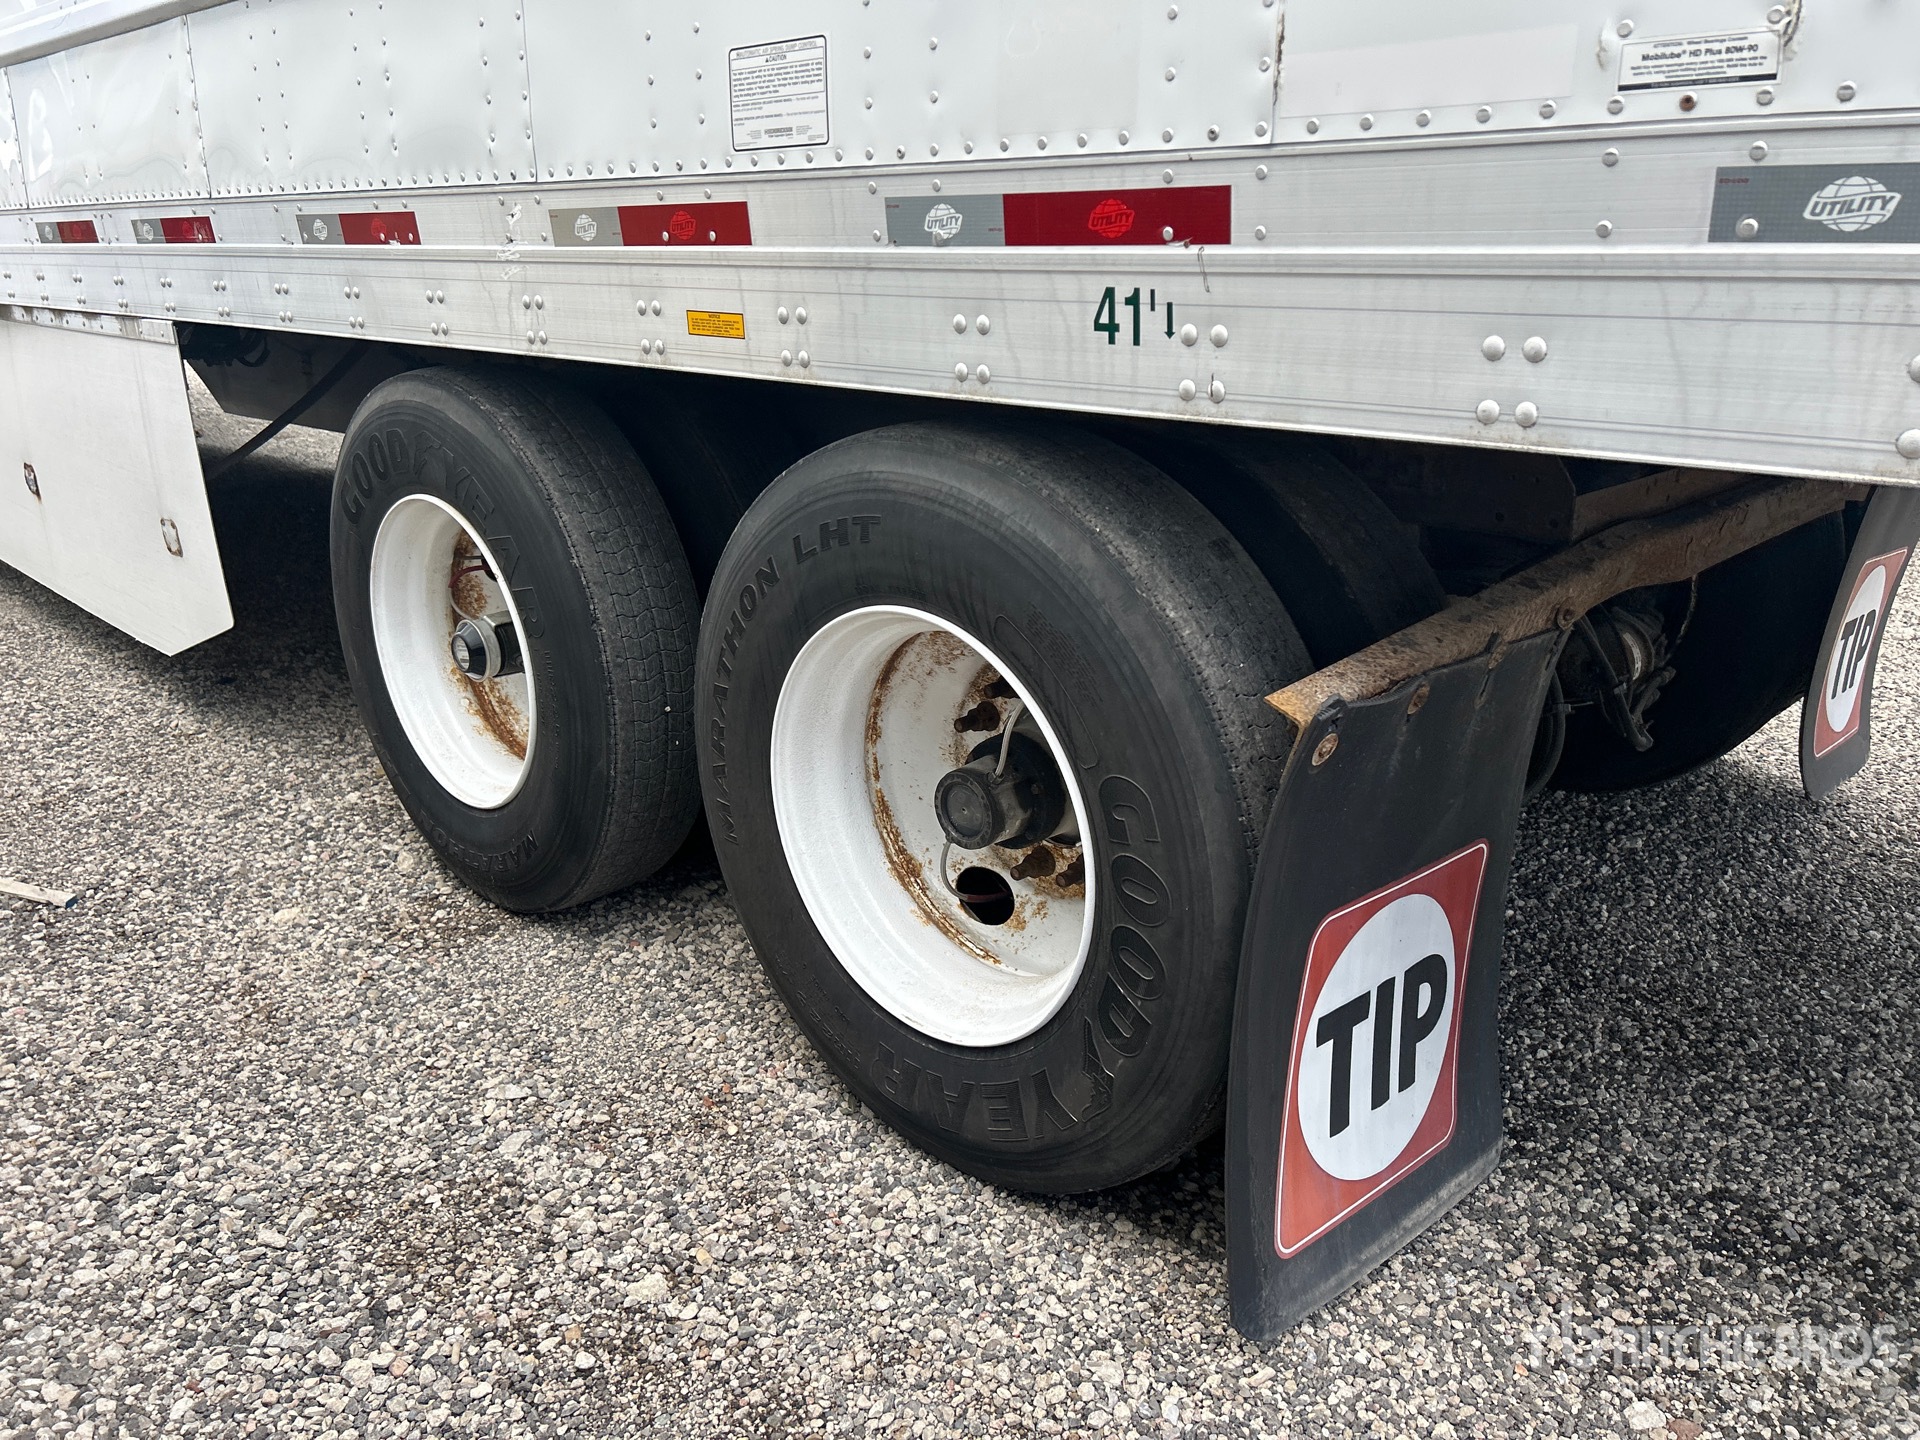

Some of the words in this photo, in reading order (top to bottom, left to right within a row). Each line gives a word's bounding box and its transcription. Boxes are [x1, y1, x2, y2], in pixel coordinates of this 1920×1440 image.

[769, 53, 787, 63] CAUTION
[1689, 48, 1703, 58] HD
[1704, 47, 1723, 57] Plus
[1724, 43, 1760, 55] 80W-90
[1809, 194, 1896, 218] UTILITY
[575, 222, 597, 235] UTILITY
[926, 214, 961, 230] UTILITY
[1091, 210, 1134, 231] UTILITY
[1831, 609, 1877, 700] TIP
[711, 556, 781, 846] MARATHON
[792, 514, 882, 565] LHT
[873, 774, 1173, 1142] GOODYEAR
[1315, 953, 1449, 1139] TIP
